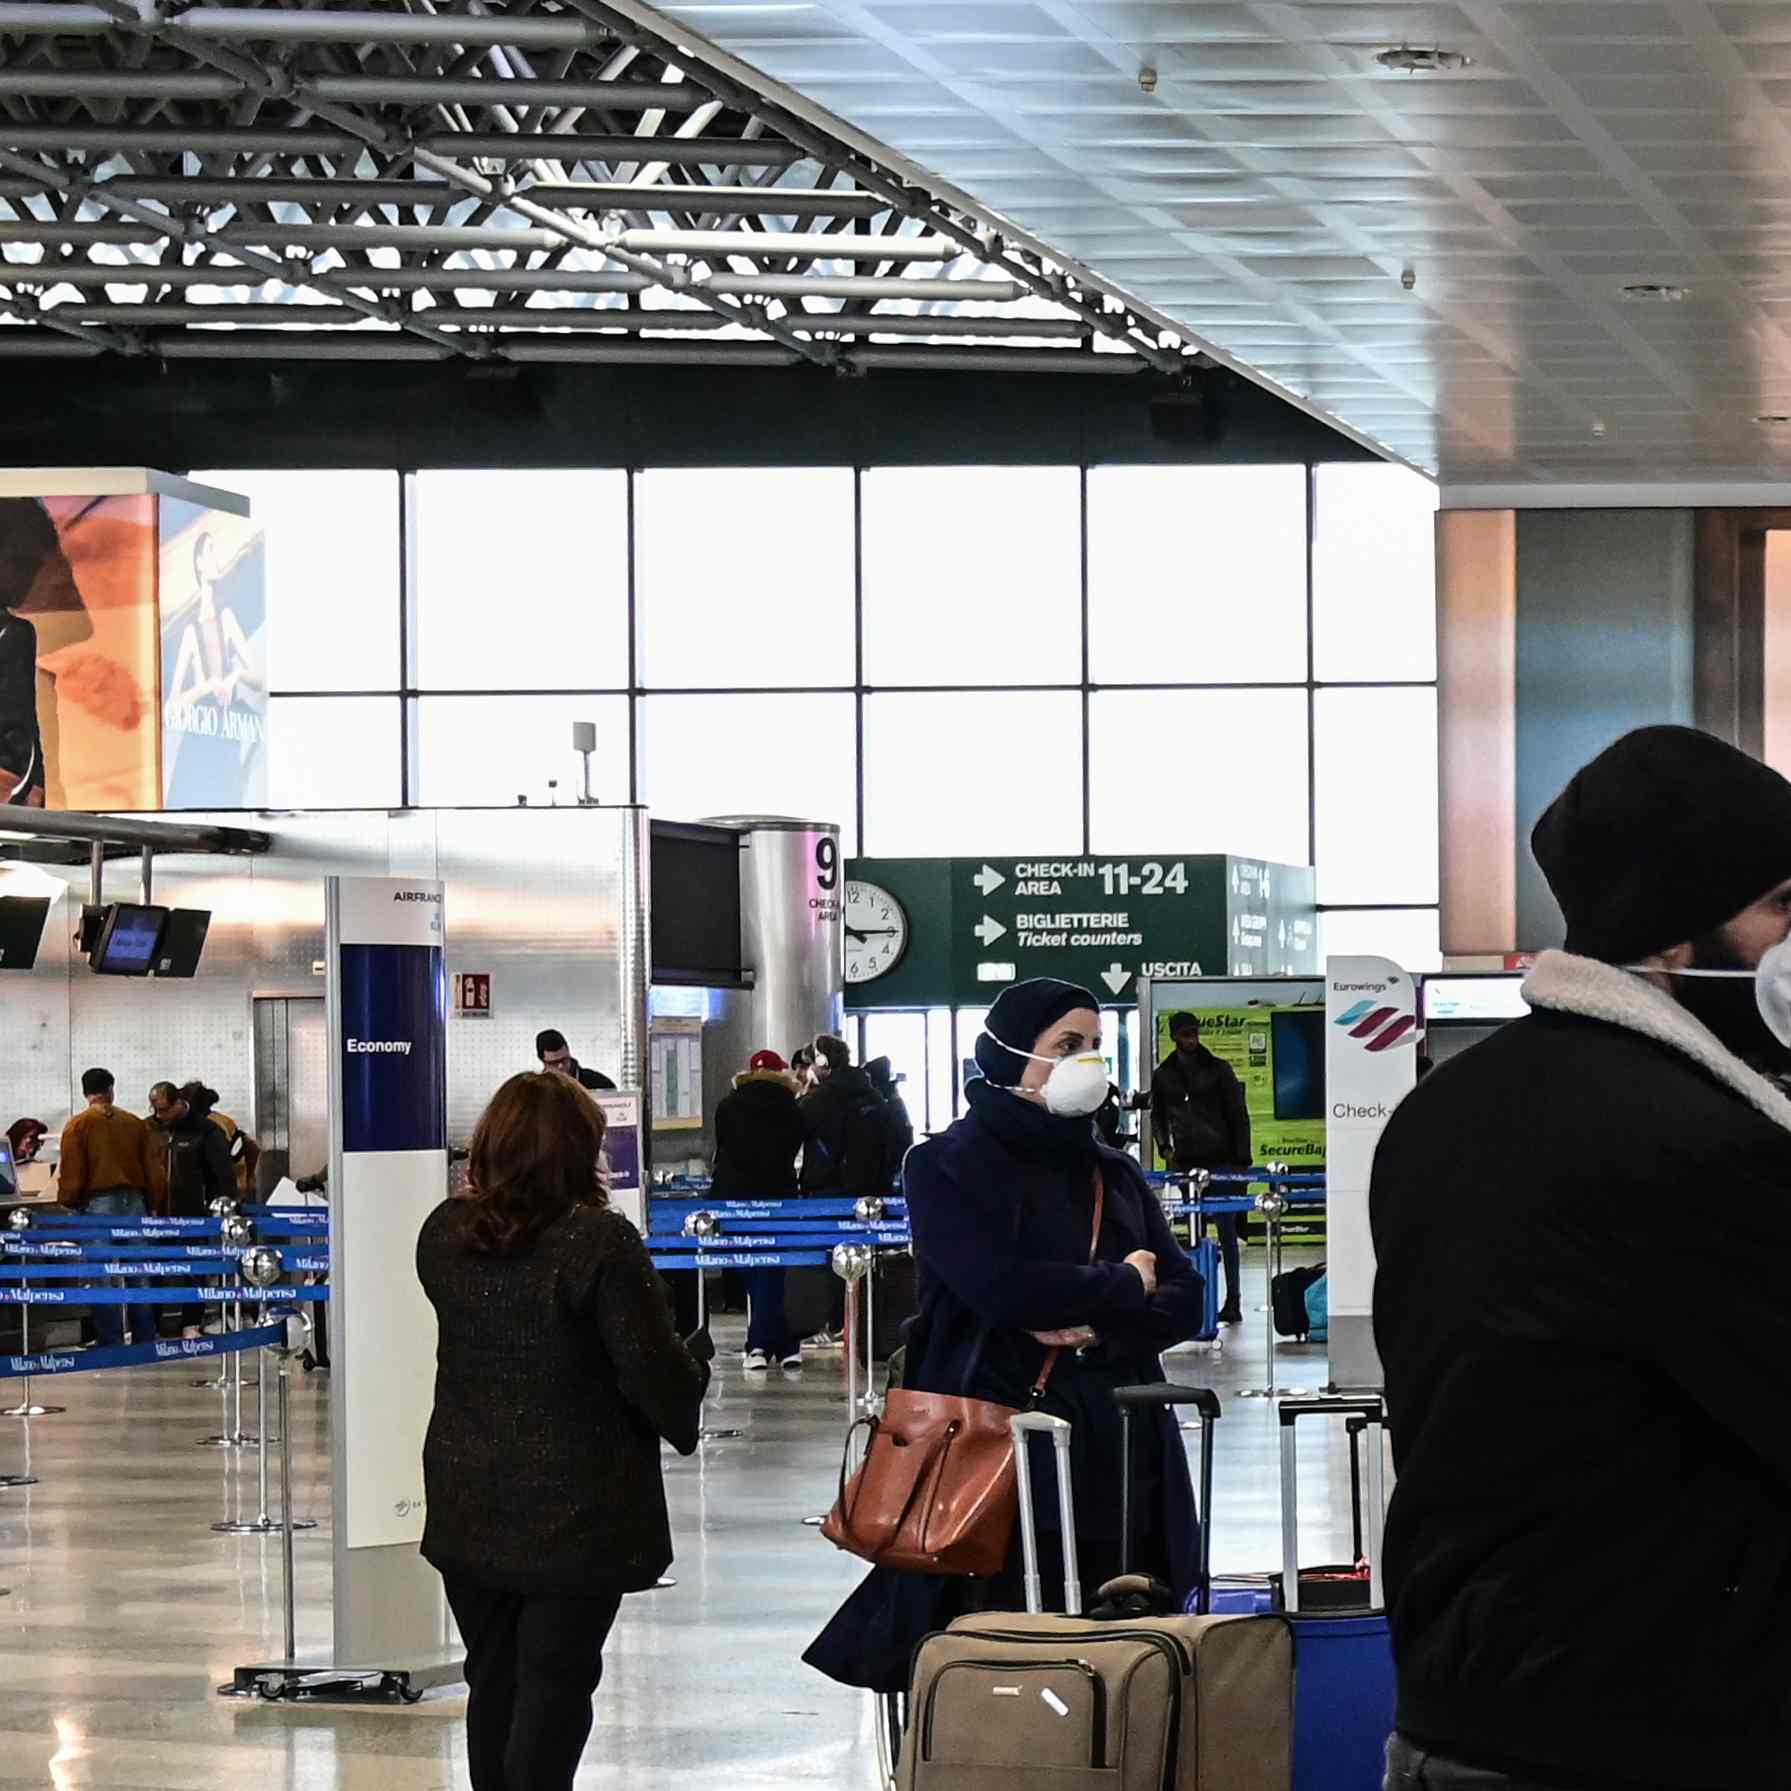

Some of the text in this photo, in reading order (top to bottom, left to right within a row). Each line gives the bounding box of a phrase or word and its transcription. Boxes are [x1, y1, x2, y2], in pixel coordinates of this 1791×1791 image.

[816, 837, 837, 890] 9
[1015, 863, 1095, 878] CHECK-IN
[1099, 862, 1189, 895] 11-24
[1015, 881, 1062, 896] AREA
[881, 908, 889, 921] 2
[1016, 913, 1129, 929] BIGLIETTERIE
[1017, 932, 1143, 948] Ticket counters
[850, 961, 859, 974] 6
[868, 957, 877, 969] 5
[1142, 962, 1203, 977] USCITA
[1333, 981, 1387, 994] Eurowings
[1198, 1015, 1246, 1028] ueStar
[346, 1038, 412, 1056] Economy
[1333, 1103, 1397, 1119] Check-
[694, 1254, 781, 1268] Milano Malpensa
[103, 1262, 192, 1277] Milano Malpensa
[8, 1289, 65, 1304] Malpensa
[197, 1286, 298, 1302] Milano Malpensa
